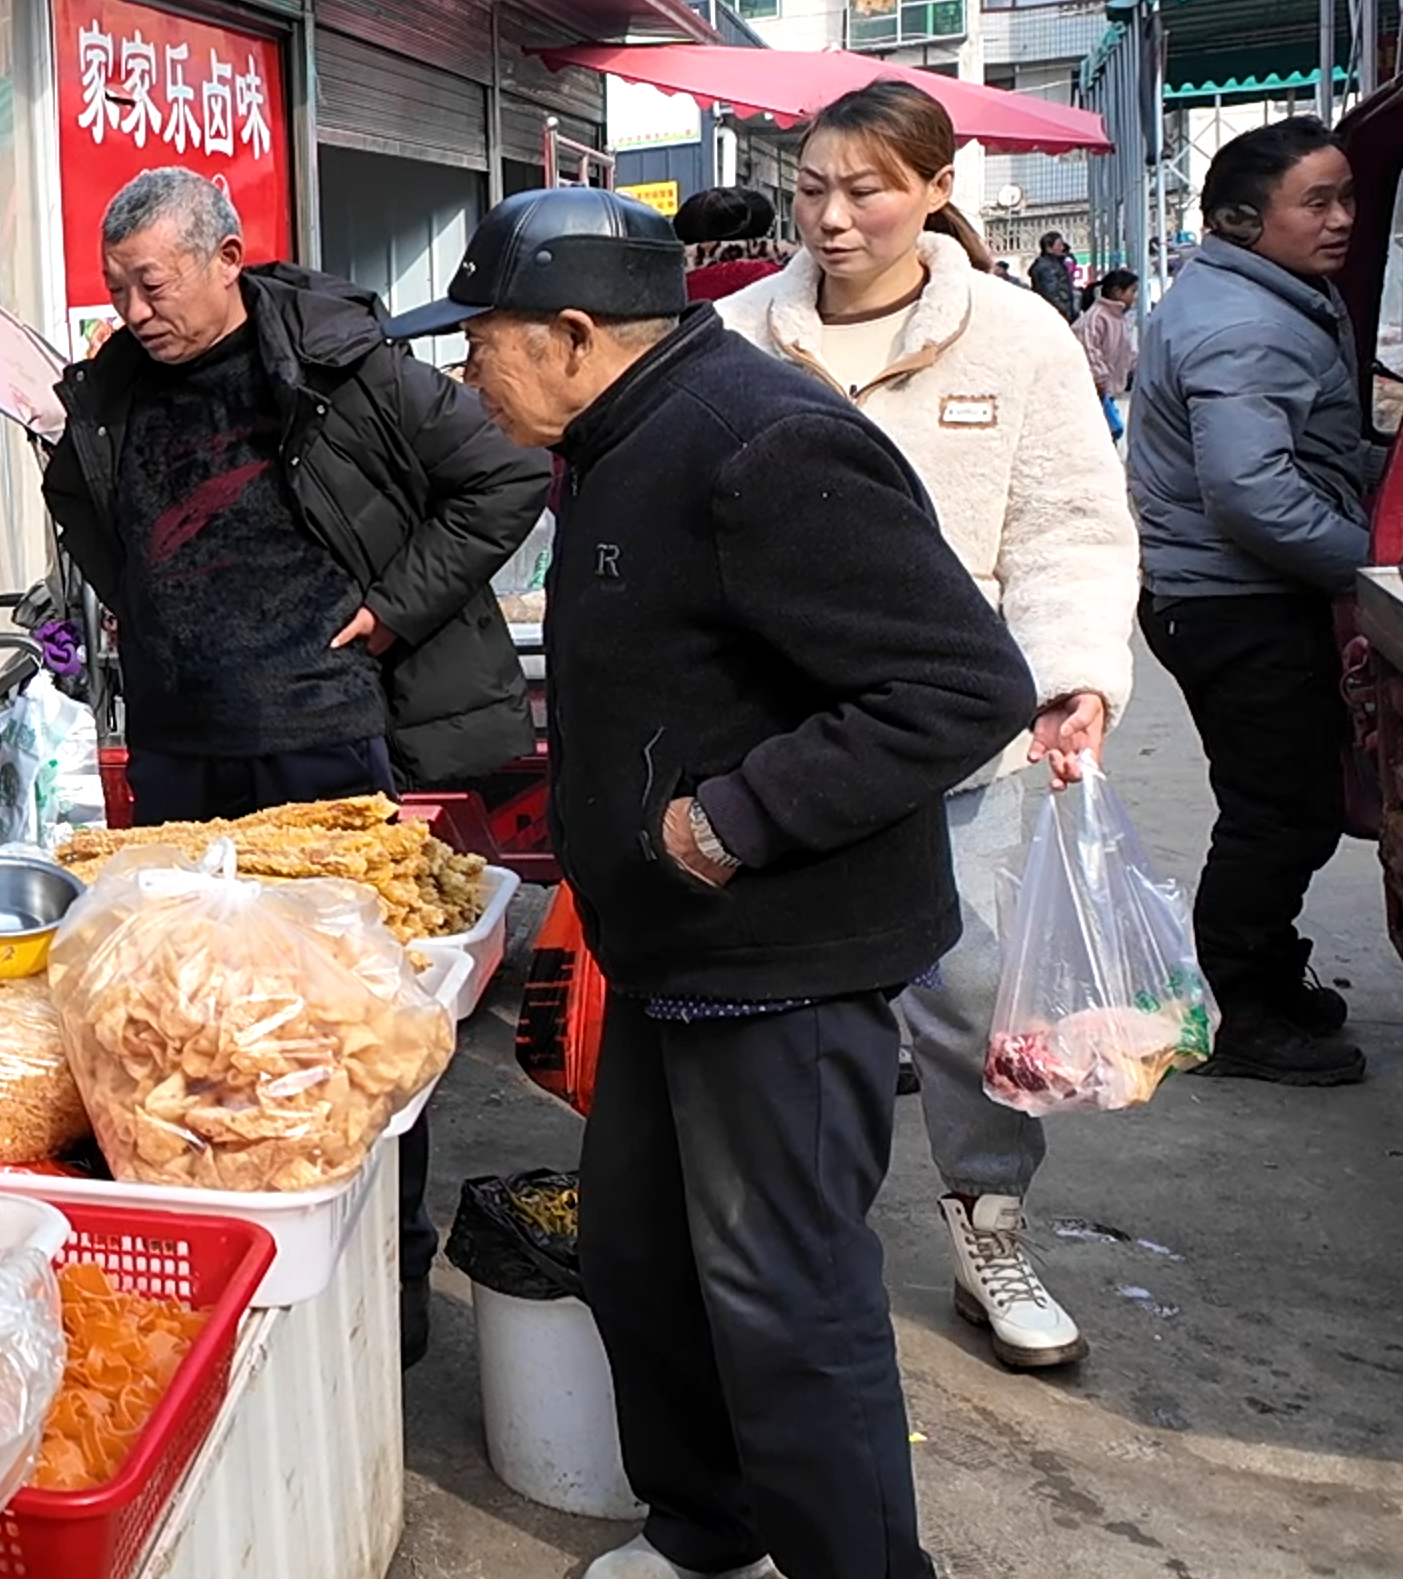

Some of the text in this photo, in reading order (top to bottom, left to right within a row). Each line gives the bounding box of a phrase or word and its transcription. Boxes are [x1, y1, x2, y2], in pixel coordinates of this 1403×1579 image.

[78, 18, 270, 160] 家家乐卤味
